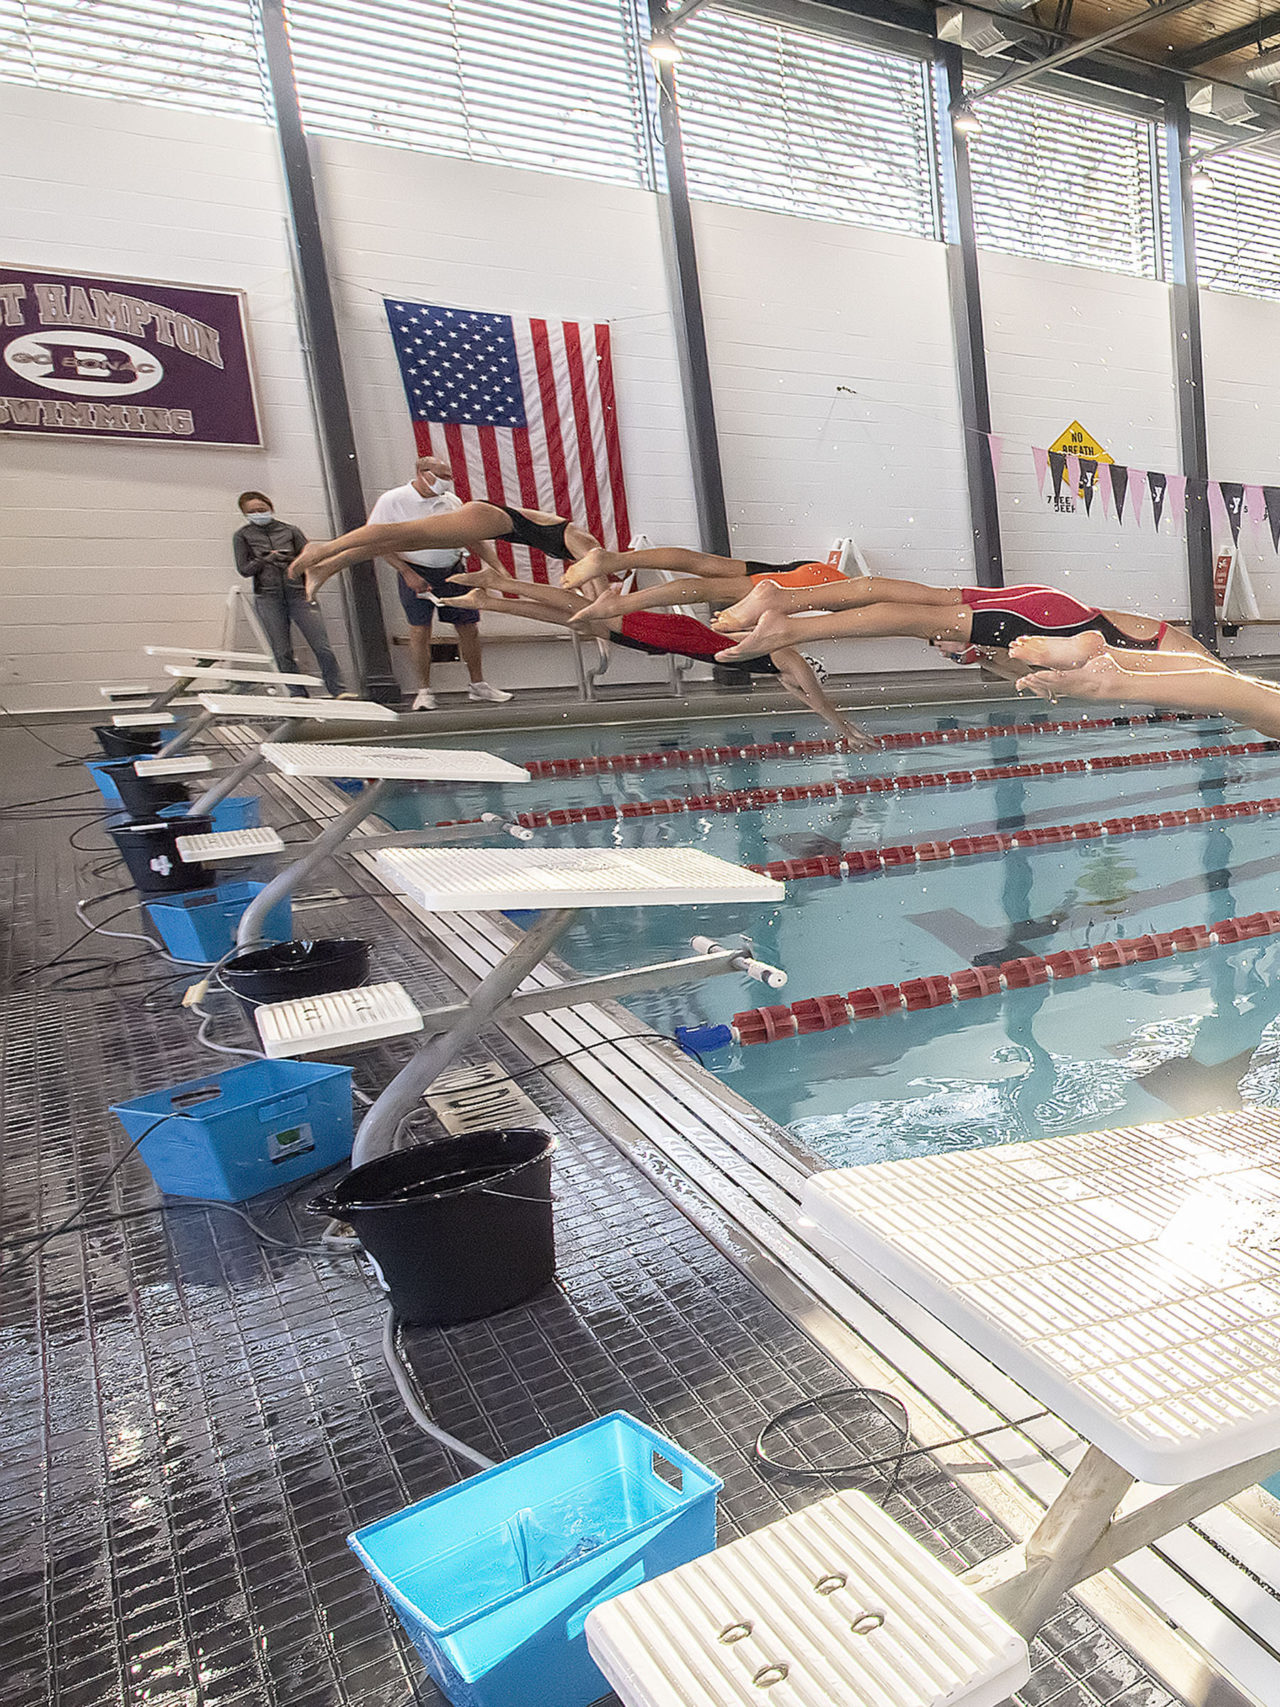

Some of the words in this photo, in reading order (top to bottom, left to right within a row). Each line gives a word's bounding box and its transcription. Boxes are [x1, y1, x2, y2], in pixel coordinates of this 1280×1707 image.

[0, 283, 26, 327] T
[33, 283, 224, 370] HAMPTON
[1071, 432, 1083, 443] NO
[1046, 495, 1052, 504] 7
[1054, 496, 1073, 505] EE
